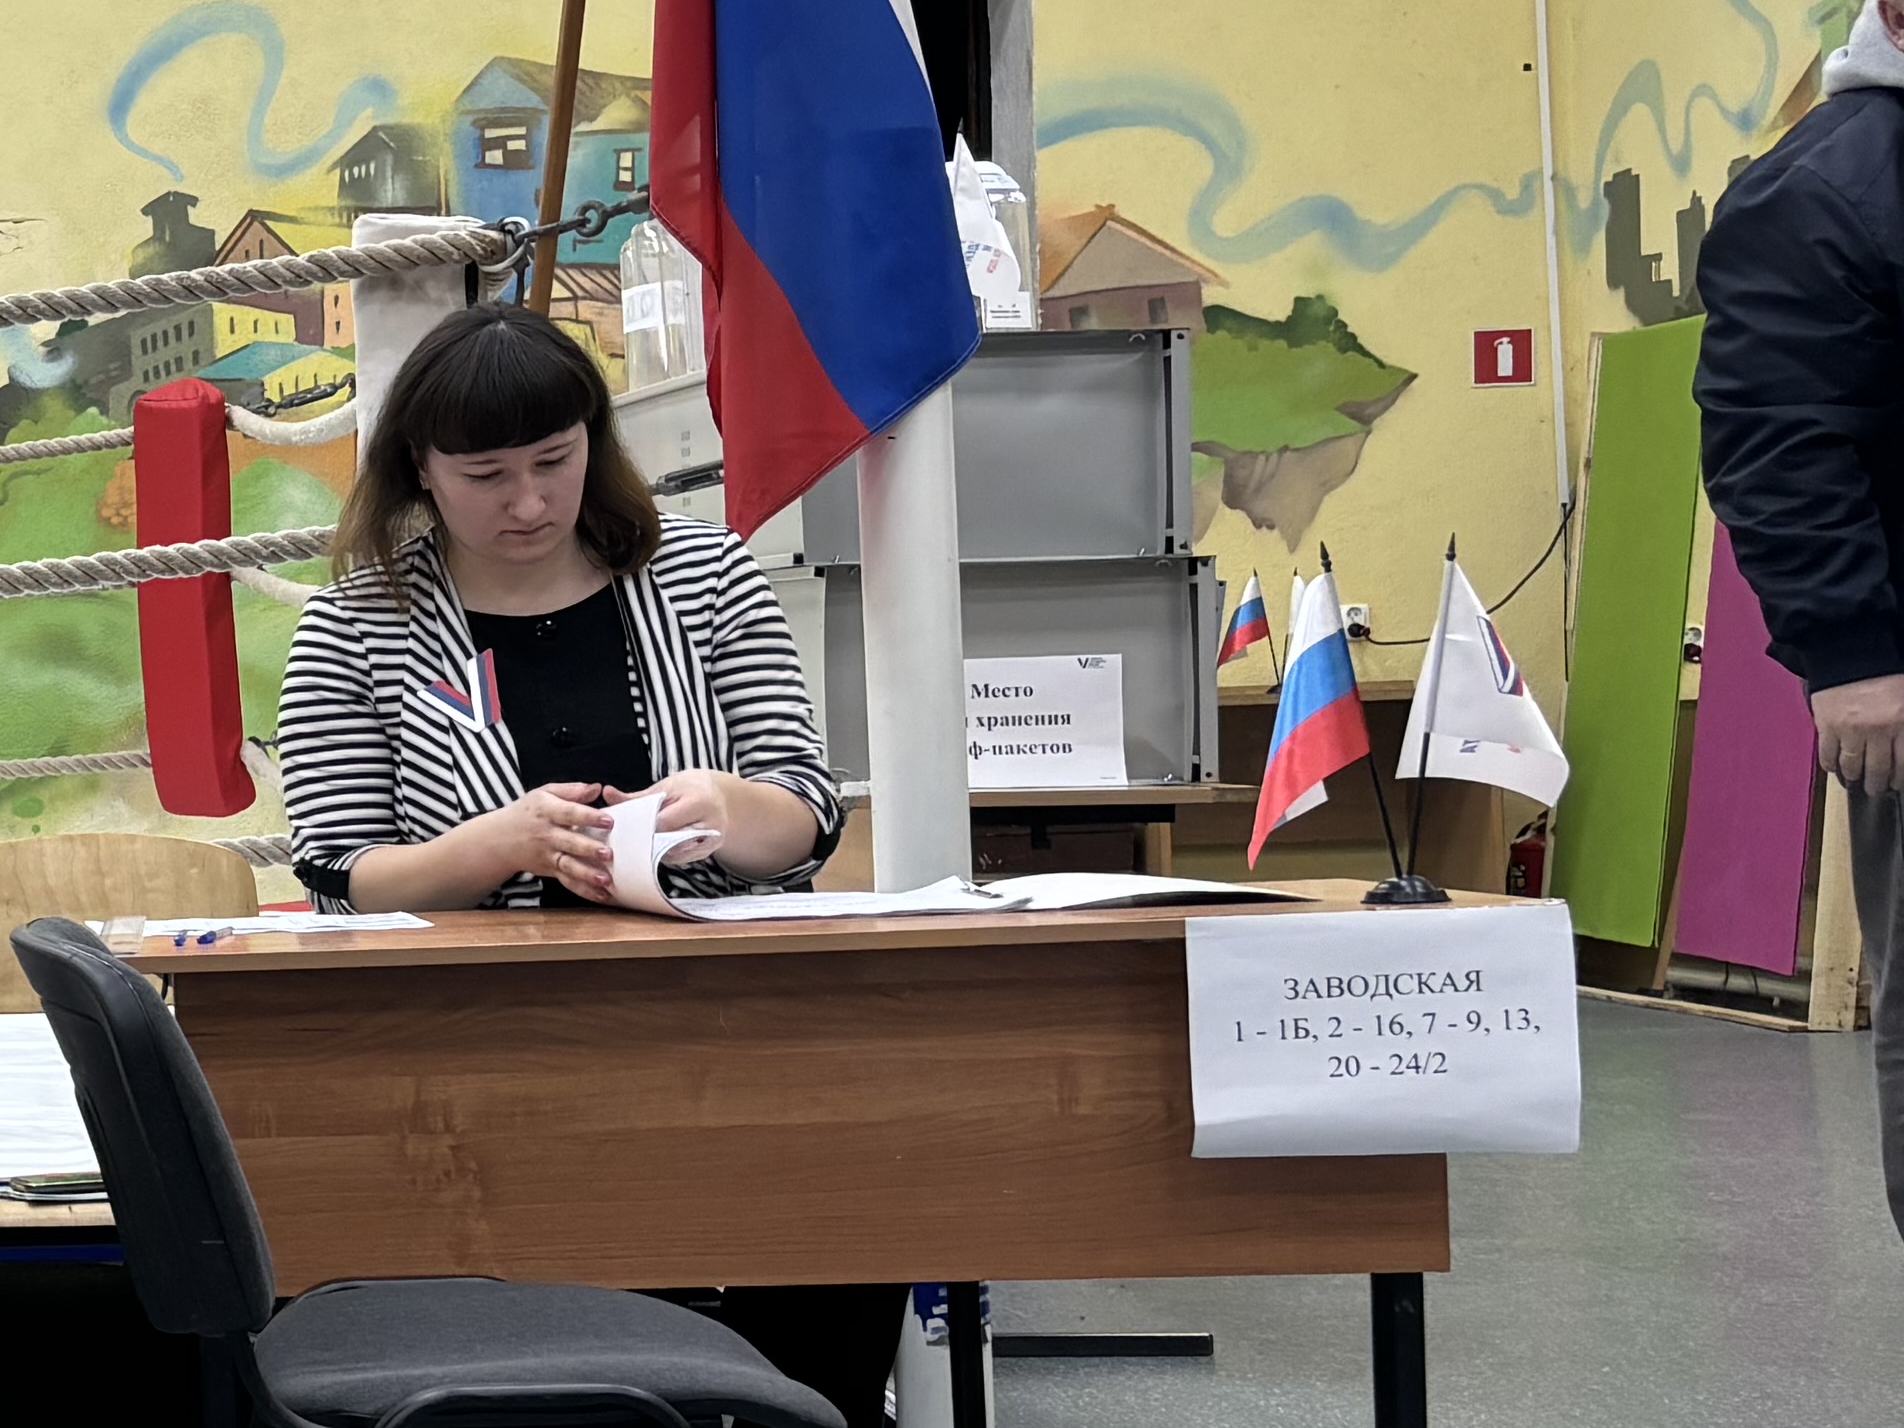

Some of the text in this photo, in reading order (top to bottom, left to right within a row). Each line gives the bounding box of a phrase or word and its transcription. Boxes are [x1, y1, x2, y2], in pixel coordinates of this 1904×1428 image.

[971, 683, 1034, 699] Место
[975, 712, 1072, 731] хранения
[968, 740, 1073, 761] ф-пакетов
[1283, 969, 1483, 1002] ЗАВОДСКАЯ
[1236, 1020, 1244, 1042] 1
[1279, 1017, 1319, 1043] 1Б,
[1327, 1016, 1343, 1038] 2
[1375, 1013, 1413, 1039] 16,
[1421, 1012, 1437, 1035] 7
[1466, 1010, 1491, 1034] 9,
[1503, 1007, 1541, 1033] 13,
[1328, 1055, 1361, 1078] 20
[1389, 1051, 1448, 1076] 24/2
